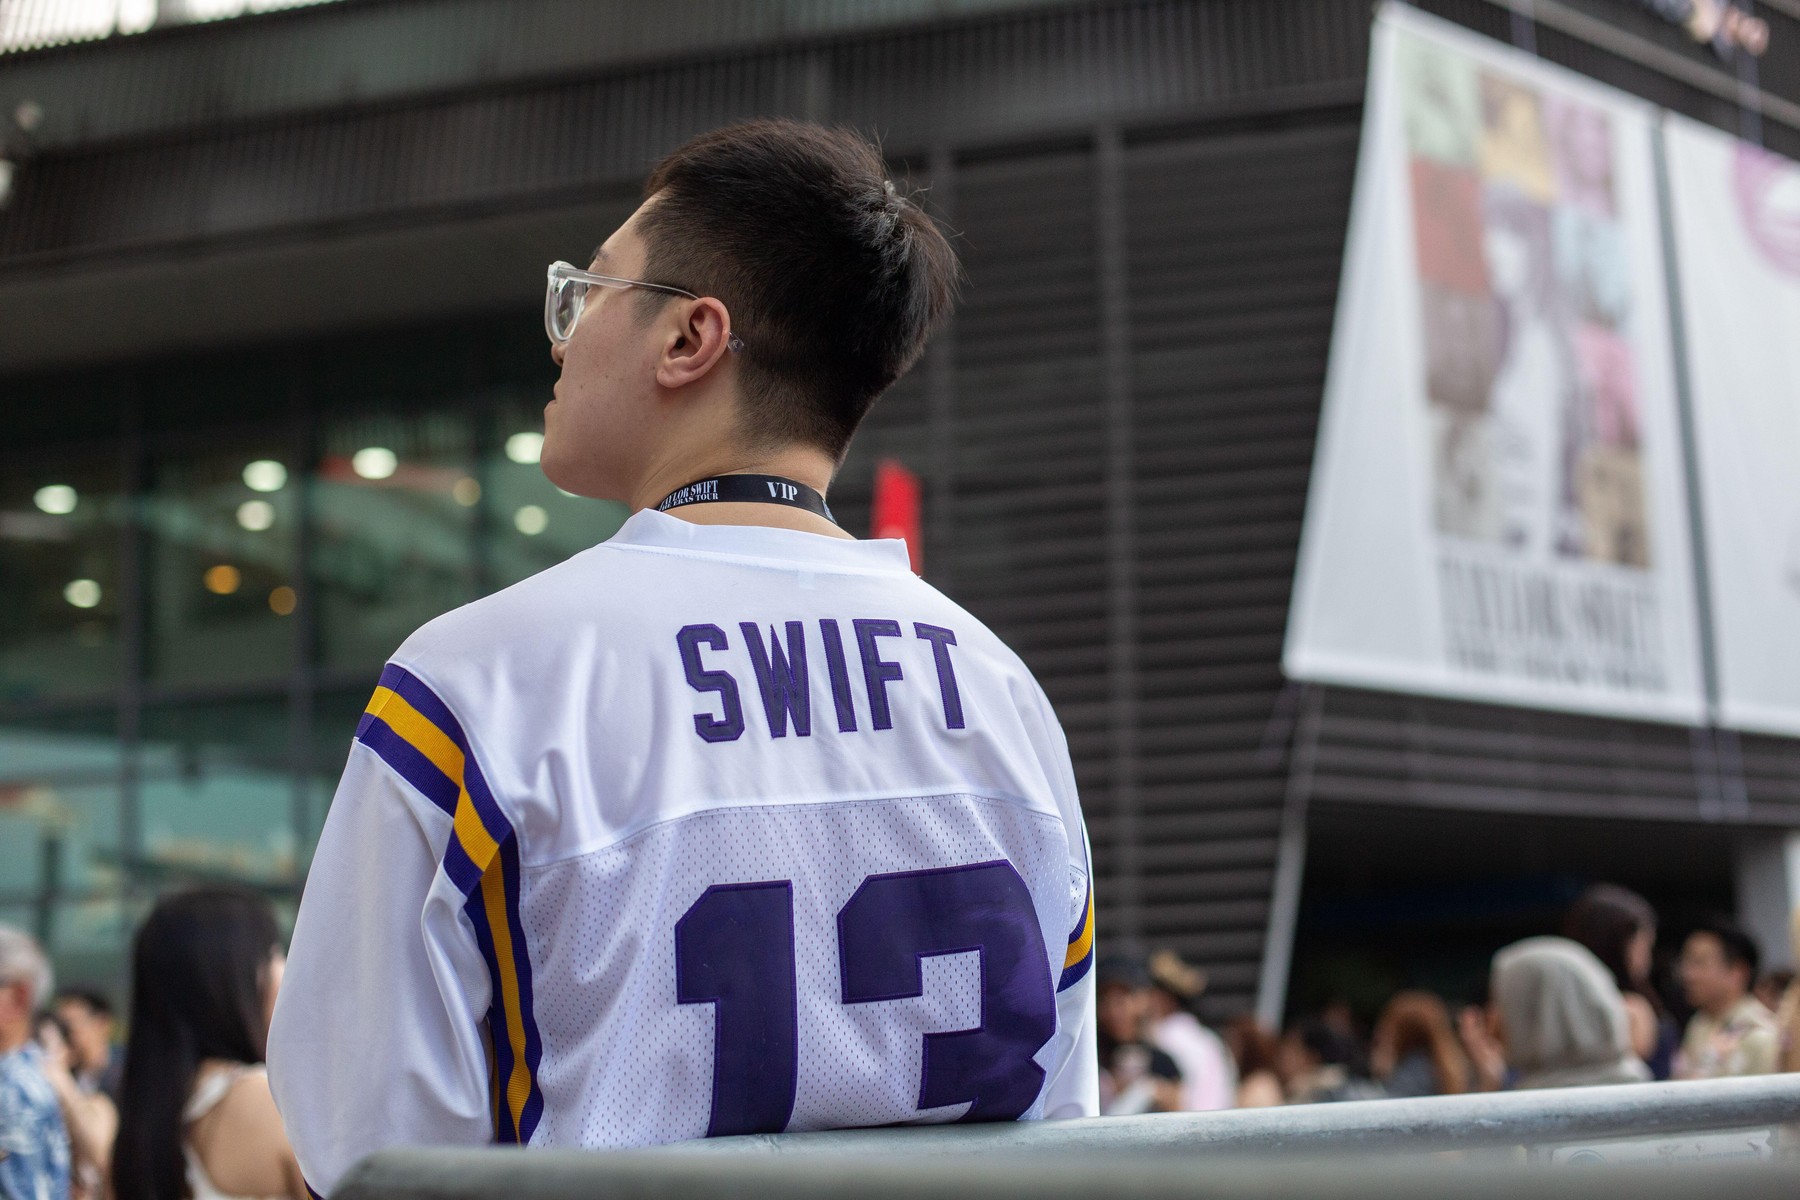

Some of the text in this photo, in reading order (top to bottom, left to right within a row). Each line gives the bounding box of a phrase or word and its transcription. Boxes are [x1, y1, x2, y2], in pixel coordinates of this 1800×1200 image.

[690, 480, 719, 496] SWIFT
[695, 493, 719, 501] TOUR
[766, 481, 798, 501] VIP
[676, 618, 966, 743] SWIFT
[674, 859, 1056, 1138] 13
